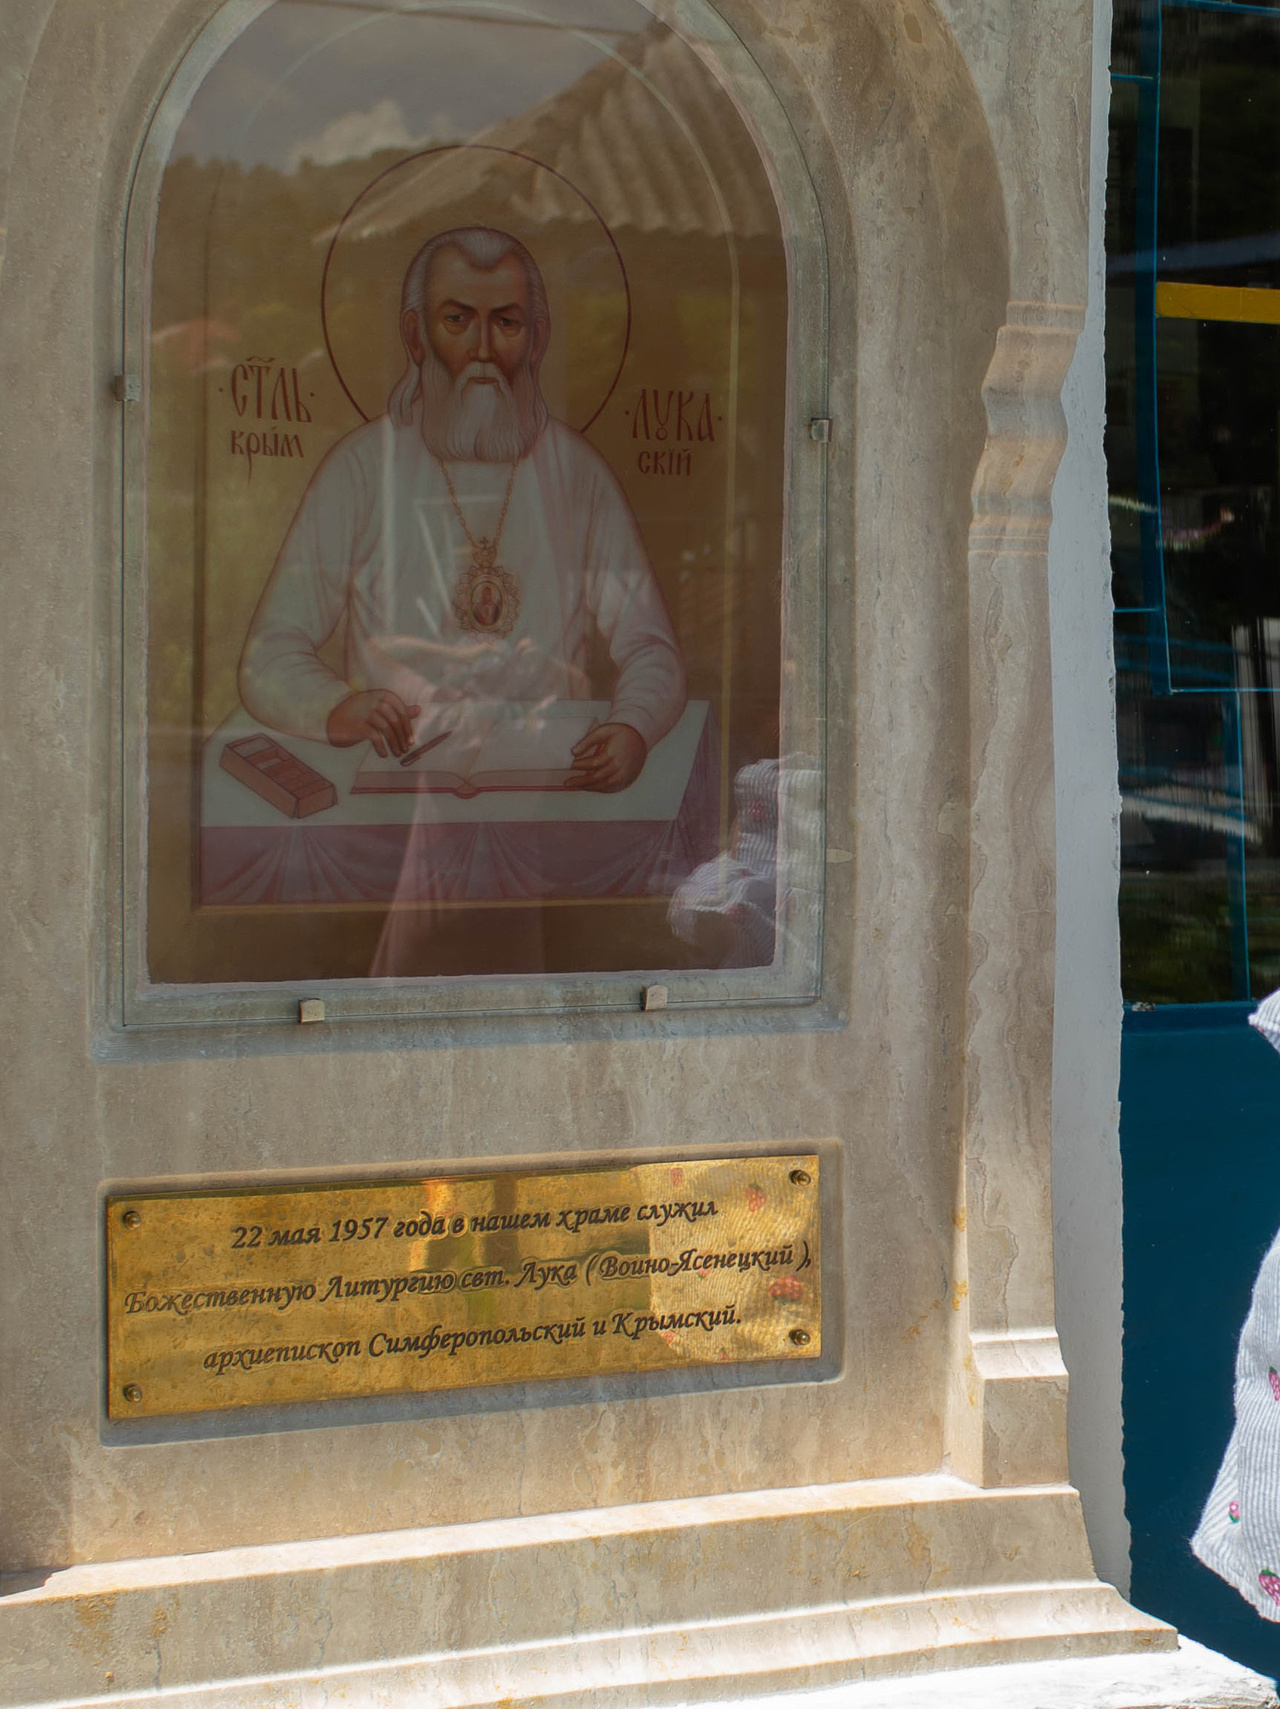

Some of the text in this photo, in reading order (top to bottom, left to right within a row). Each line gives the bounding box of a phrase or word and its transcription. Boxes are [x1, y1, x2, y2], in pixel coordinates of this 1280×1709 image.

[231, 1200, 718, 1249] 22 мая 1957 года в нашем храме служил
[124, 1284, 316, 1315] Божественную
[319, 1272, 454, 1303] Литургию
[514, 1260, 577, 1290] Лука
[203, 1304, 742, 1376] архиепископ Симферопольский и Крымский.
